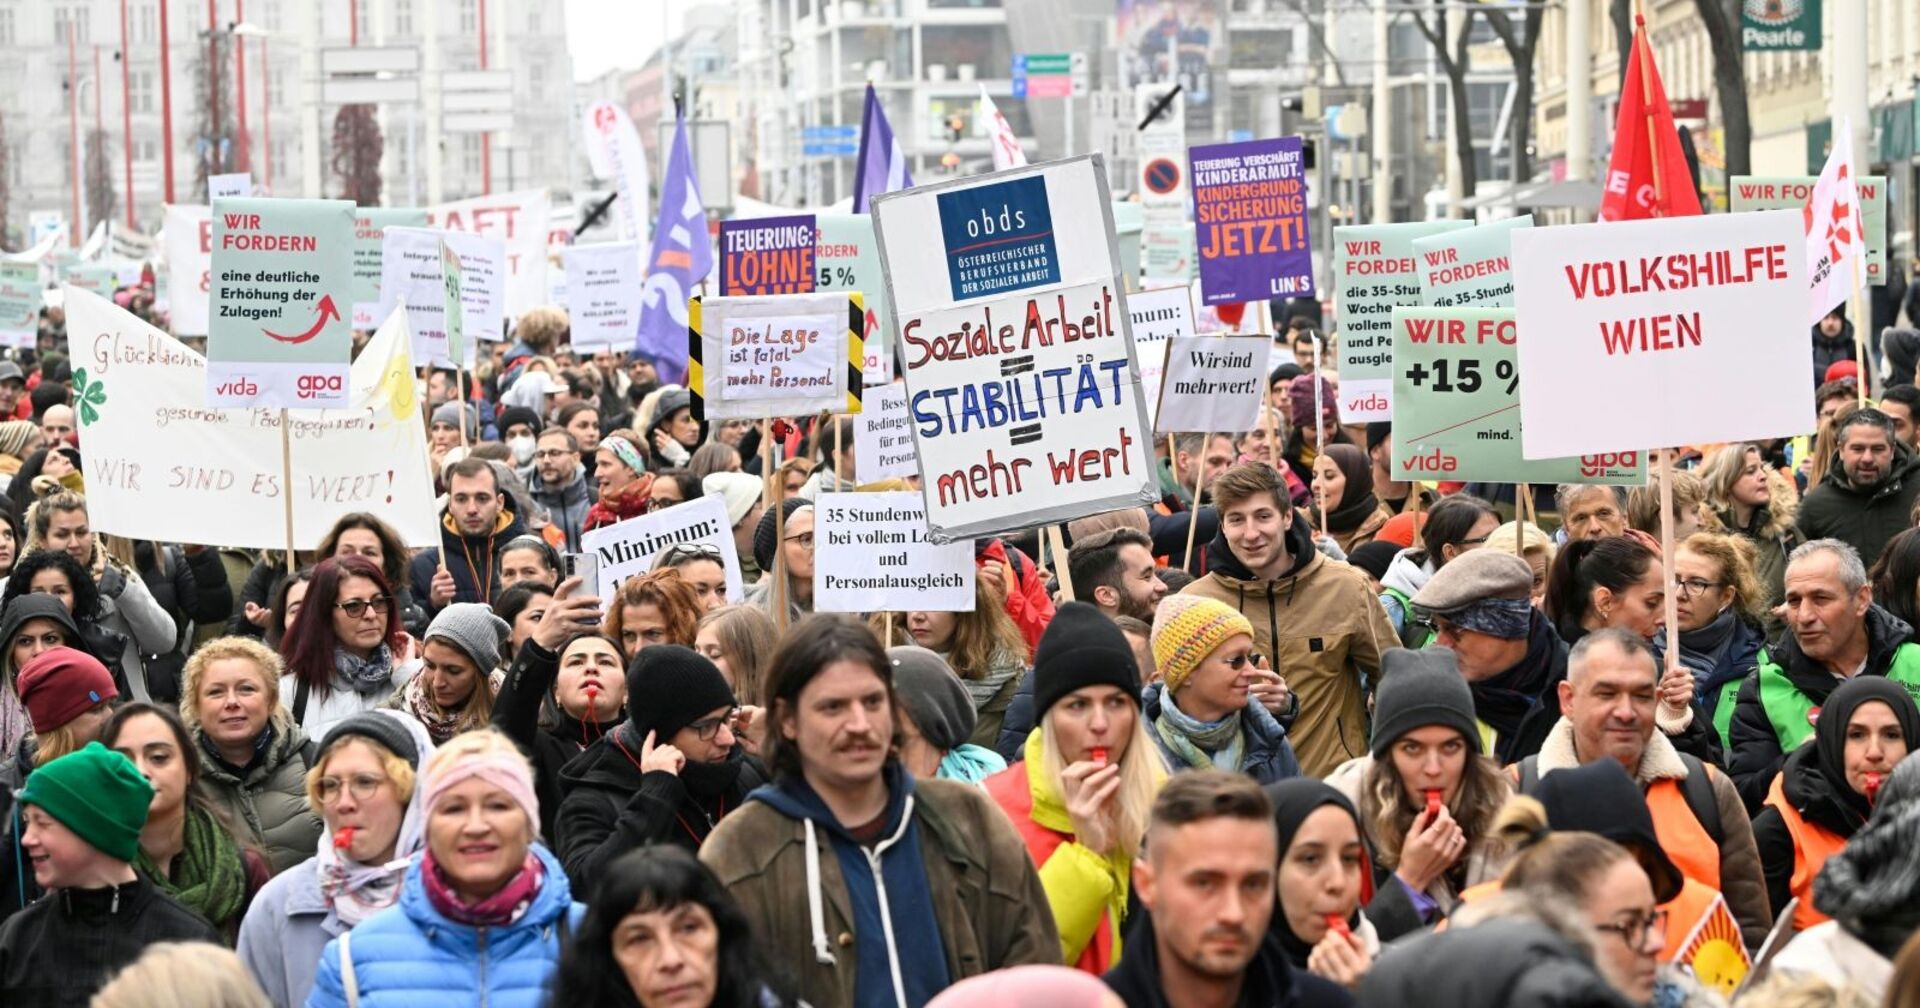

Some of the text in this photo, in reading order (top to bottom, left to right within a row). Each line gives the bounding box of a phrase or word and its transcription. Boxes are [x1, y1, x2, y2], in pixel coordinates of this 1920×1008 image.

[1743, 27, 1805, 47] Pearle
[1193, 151, 1300, 171] TEUERUNG VERSCHÄRFT
[1195, 164, 1301, 186] KINDERARMUT.
[1197, 180, 1302, 203] KINDERGRUND-
[1739, 185, 1775, 199] WIR
[1199, 196, 1303, 223] SICHERUNG
[224, 214, 261, 230] WIR
[967, 204, 1026, 237] obds
[223, 235, 316, 252] FORDERN
[726, 226, 813, 252] TEUERUNG:
[1202, 217, 1305, 259] JETZT!
[403, 252, 440, 262] Integra
[815, 245, 858, 258] RDERN
[958, 243, 1045, 269] ÖSTERREICHISCHER
[1345, 241, 1381, 256] WIR
[1424, 248, 1458, 267] WIR
[410, 272, 443, 280] brauch
[727, 248, 813, 287] LÖHNE
[960, 257, 1047, 281] BERUFSVERBAND
[1346, 257, 1416, 275] FORDE
[1429, 256, 1510, 287] FORDERN
[1565, 245, 1788, 300] VOLKSHILFE
[221, 270, 320, 283] eine deutliche
[962, 269, 1049, 294] DER SOZIALEN ARBEIT
[220, 287, 316, 303] Erhöhung der
[1346, 286, 1367, 298] die
[220, 306, 282, 320] Zulagen!
[1347, 303, 1392, 314] Woche
[904, 286, 1115, 369] Soziale Arbeit
[1347, 320, 1392, 331] vollem
[1404, 319, 1466, 344] WIR
[1600, 312, 1702, 355] WIEN
[731, 324, 819, 354] Die Lage
[1348, 336, 1373, 347] und
[730, 347, 791, 366] ist fatal
[727, 366, 833, 388] mehr Personal
[1406, 359, 1482, 393] +15
[216, 375, 342, 399] vida gpa
[912, 353, 1128, 438] STABILITÄT
[1348, 393, 1388, 412] vida
[879, 437, 894, 449] für
[1477, 429, 1514, 440] mind.
[937, 427, 1132, 507] mehr wert
[1402, 448, 1457, 472] vida
[168, 465, 235, 491] SIND
[252, 473, 279, 498] ES
[826, 508, 844, 523] 35
[598, 518, 719, 568] Minimum:
[829, 530, 851, 545] bei
[856, 529, 906, 544] vollem
[878, 552, 908, 566] und
[825, 573, 964, 591] Personalausgleich
